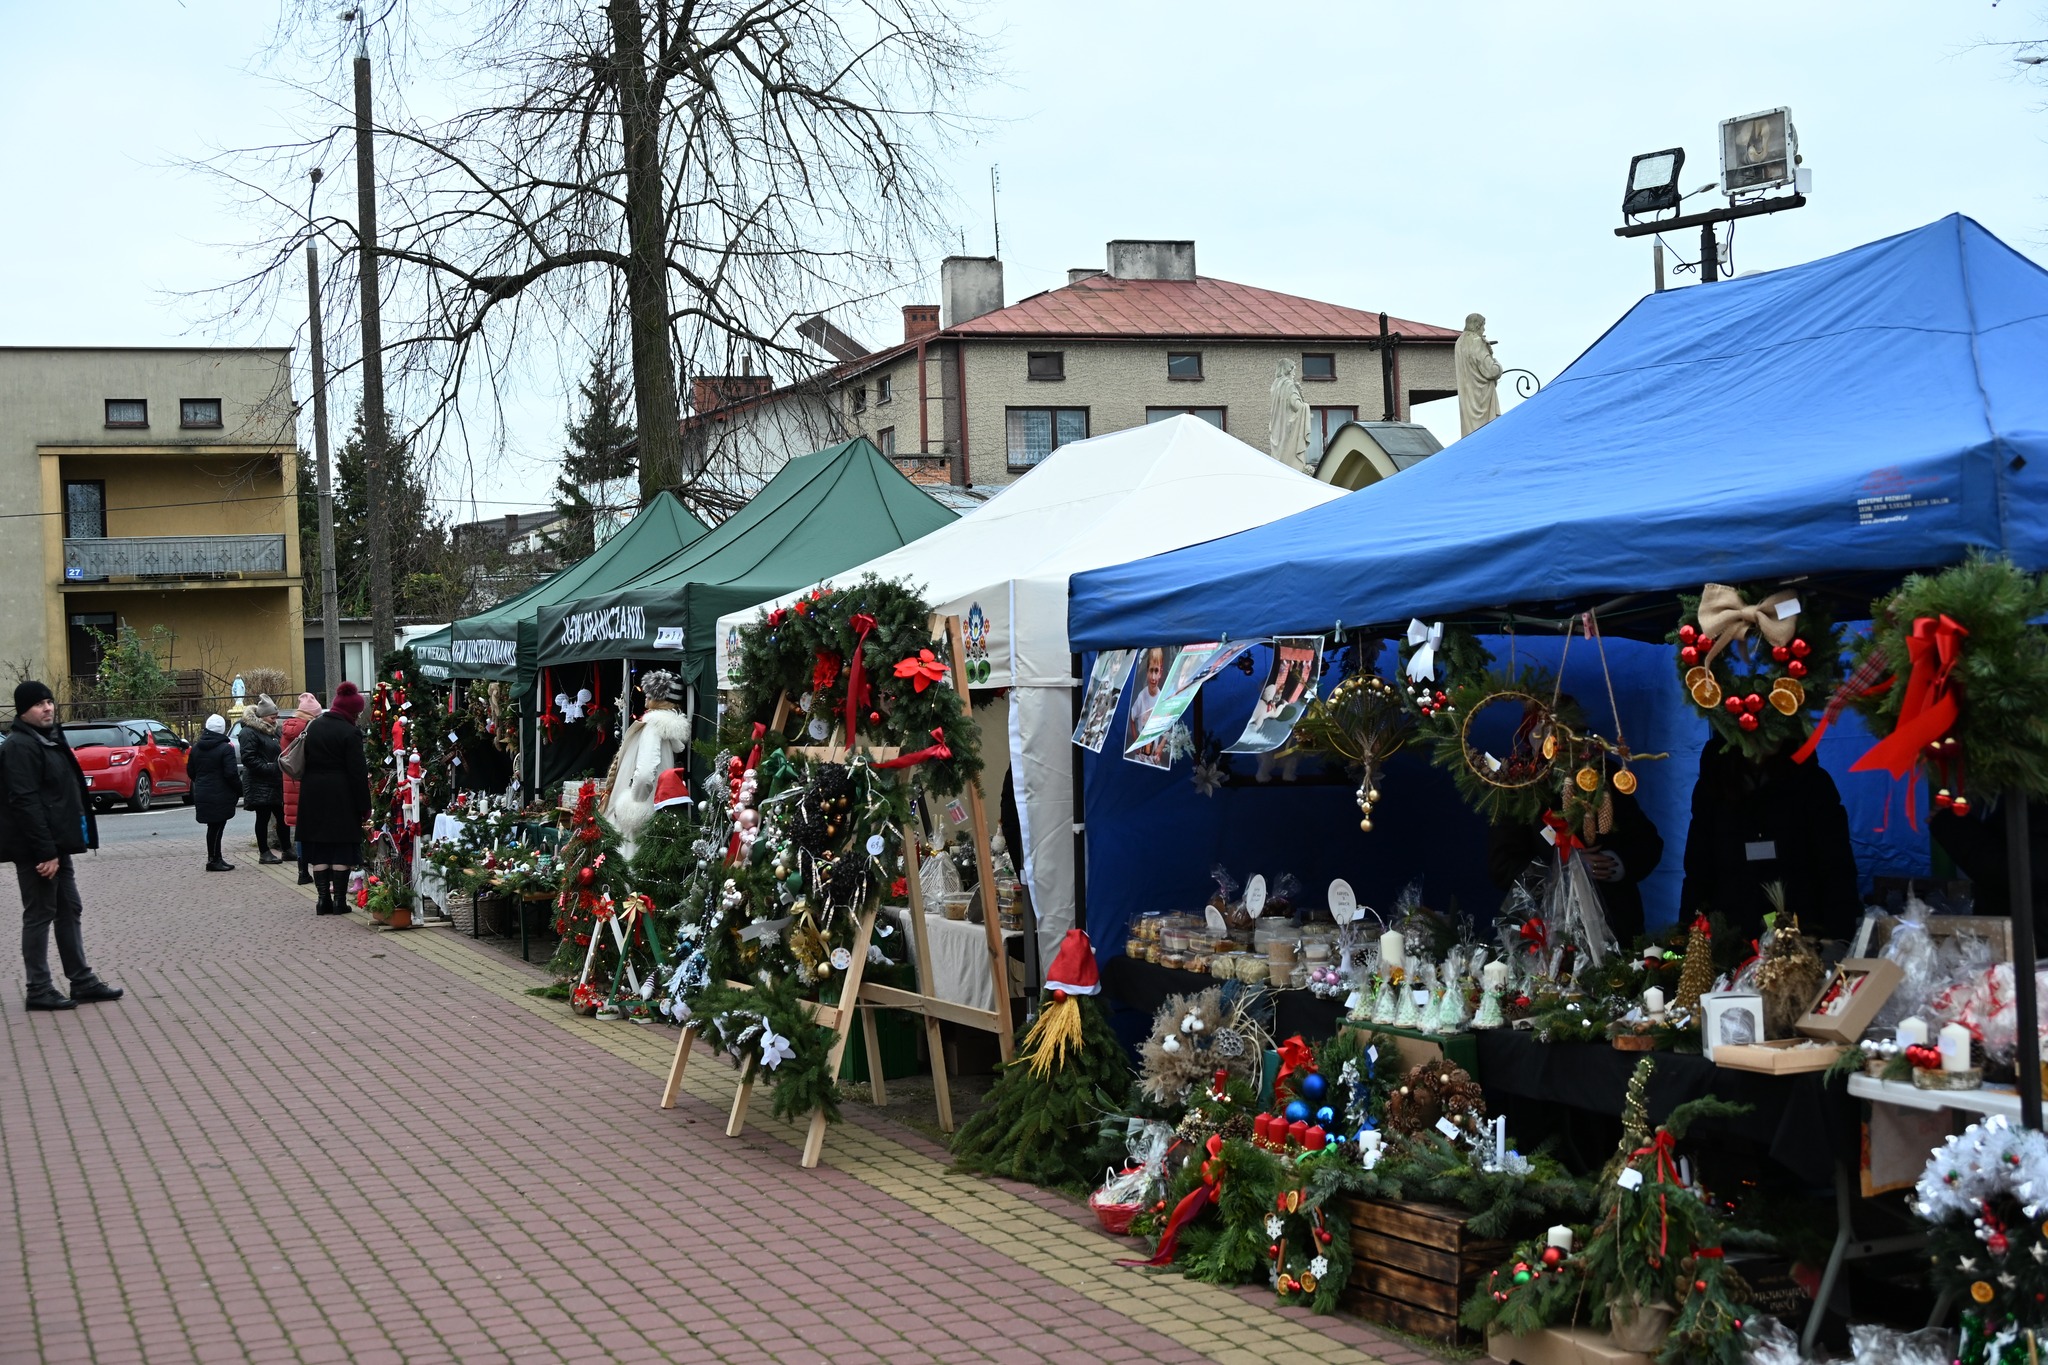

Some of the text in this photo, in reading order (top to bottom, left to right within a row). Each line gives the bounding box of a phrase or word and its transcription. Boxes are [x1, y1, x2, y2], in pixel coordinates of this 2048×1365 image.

[68, 568, 81, 576] 27
[561, 605, 646, 646] KGW BRANICZANKI
